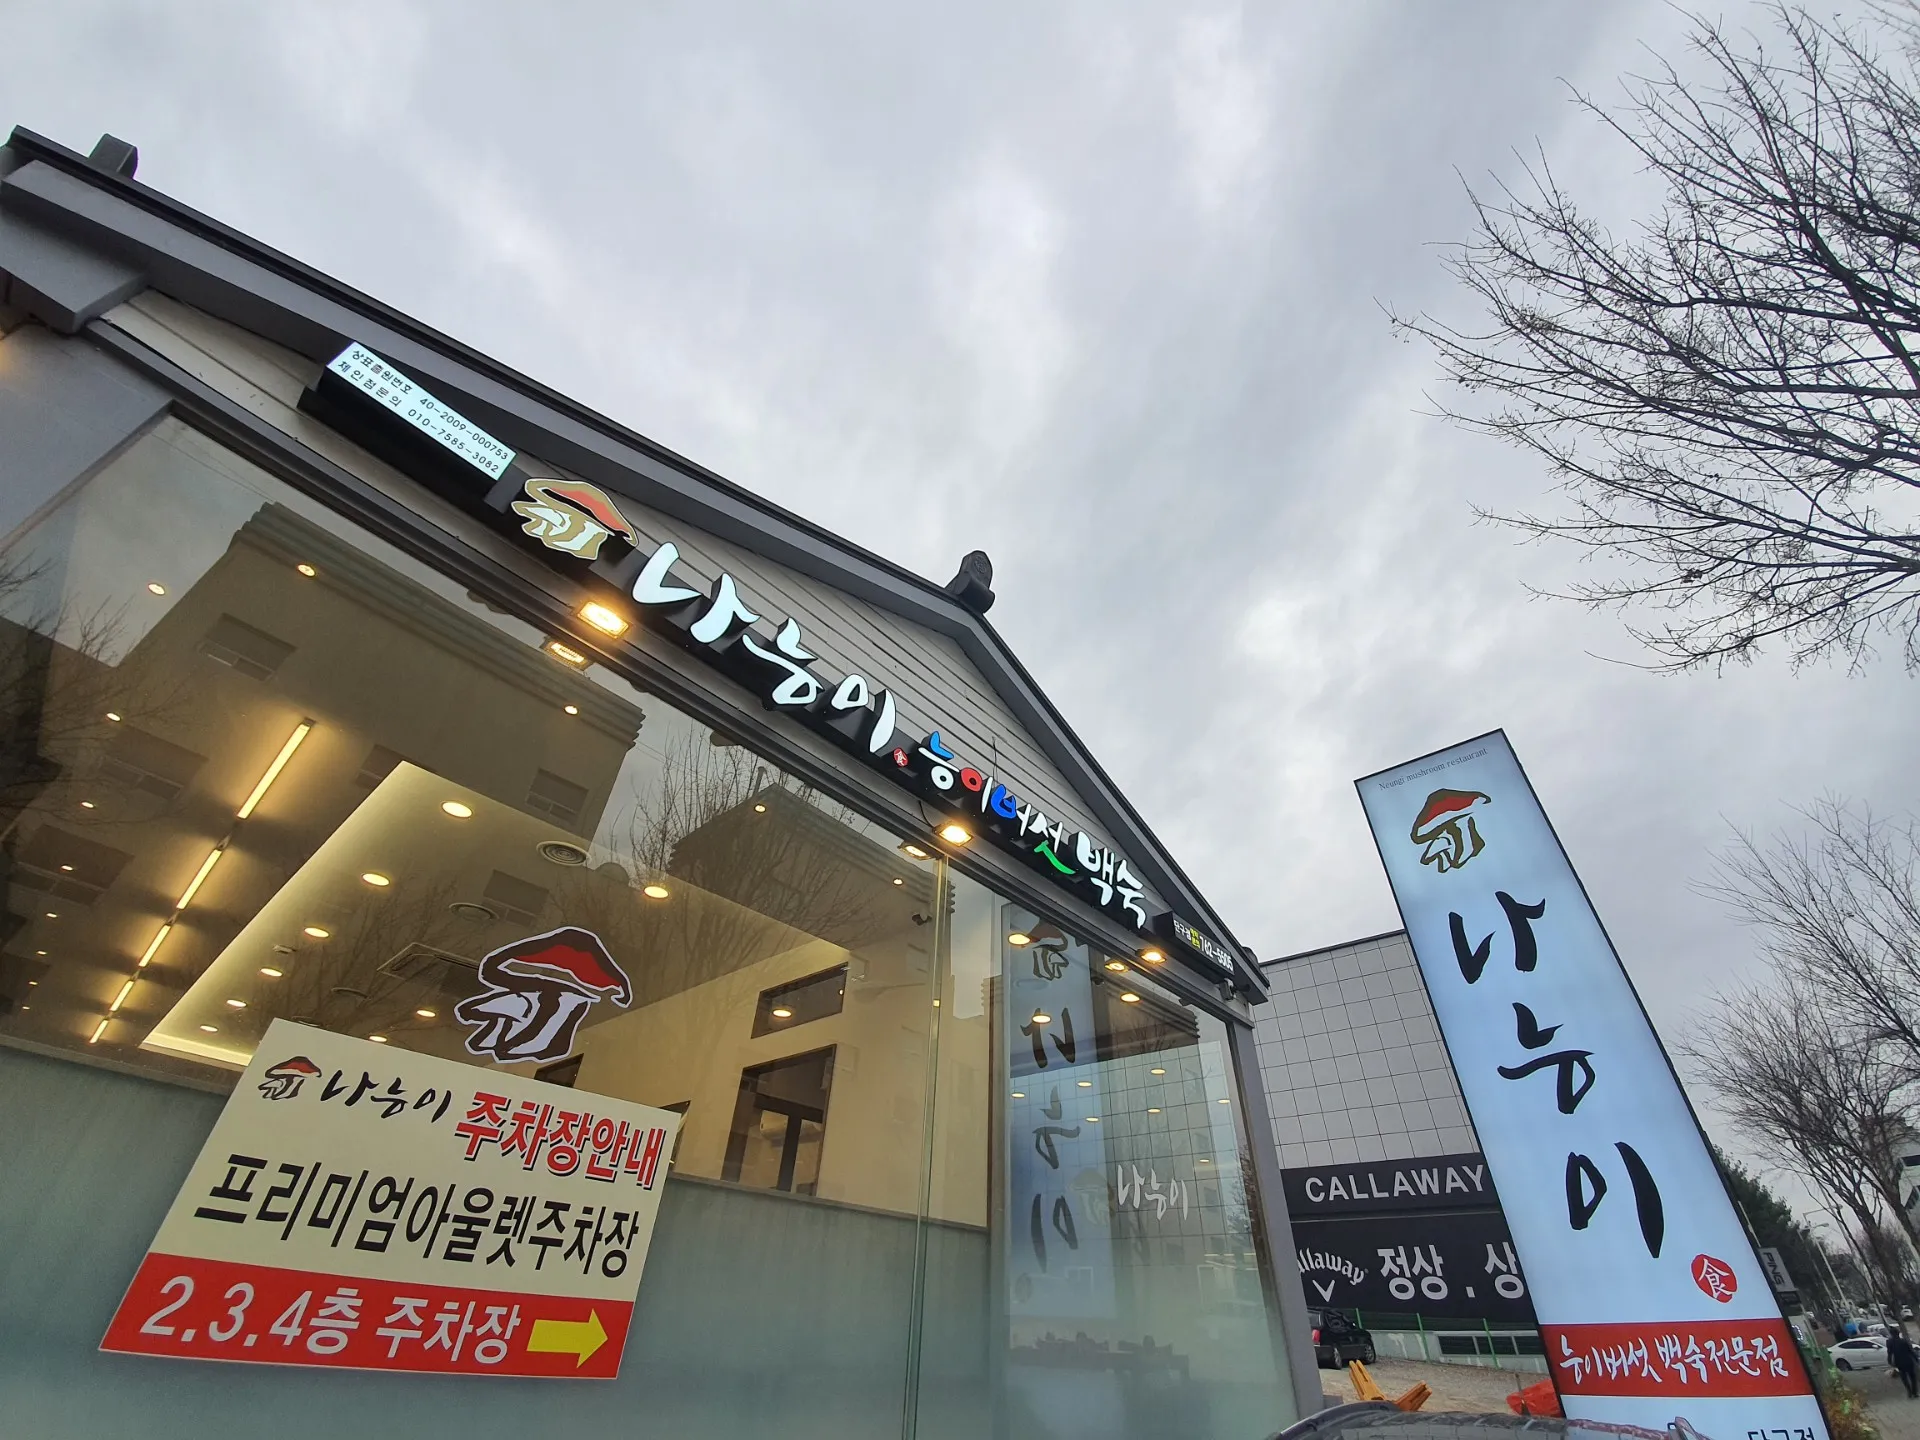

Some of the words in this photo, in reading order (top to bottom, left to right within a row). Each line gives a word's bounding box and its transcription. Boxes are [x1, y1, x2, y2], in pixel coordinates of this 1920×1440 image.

[351, 350, 413, 395] 상표출원번호
[419, 398, 509, 460] 40-2009-000753
[407, 408, 499, 473] 010-7585-3082
[631, 541, 897, 753] 나능이
[1378, 775, 1406, 791] Neungi
[1406, 763, 1446, 782] mushroom
[1447, 747, 1488, 768] restaurant
[319, 1068, 454, 1121] 나능이
[454, 1090, 668, 1192] 주차장안내
[1305, 1164, 1484, 1203] CALLAWAY
[1697, 1258, 1737, 1299] 食
[1763, 1251, 1786, 1287] PING
[375, 1294, 522, 1365] 주차장
